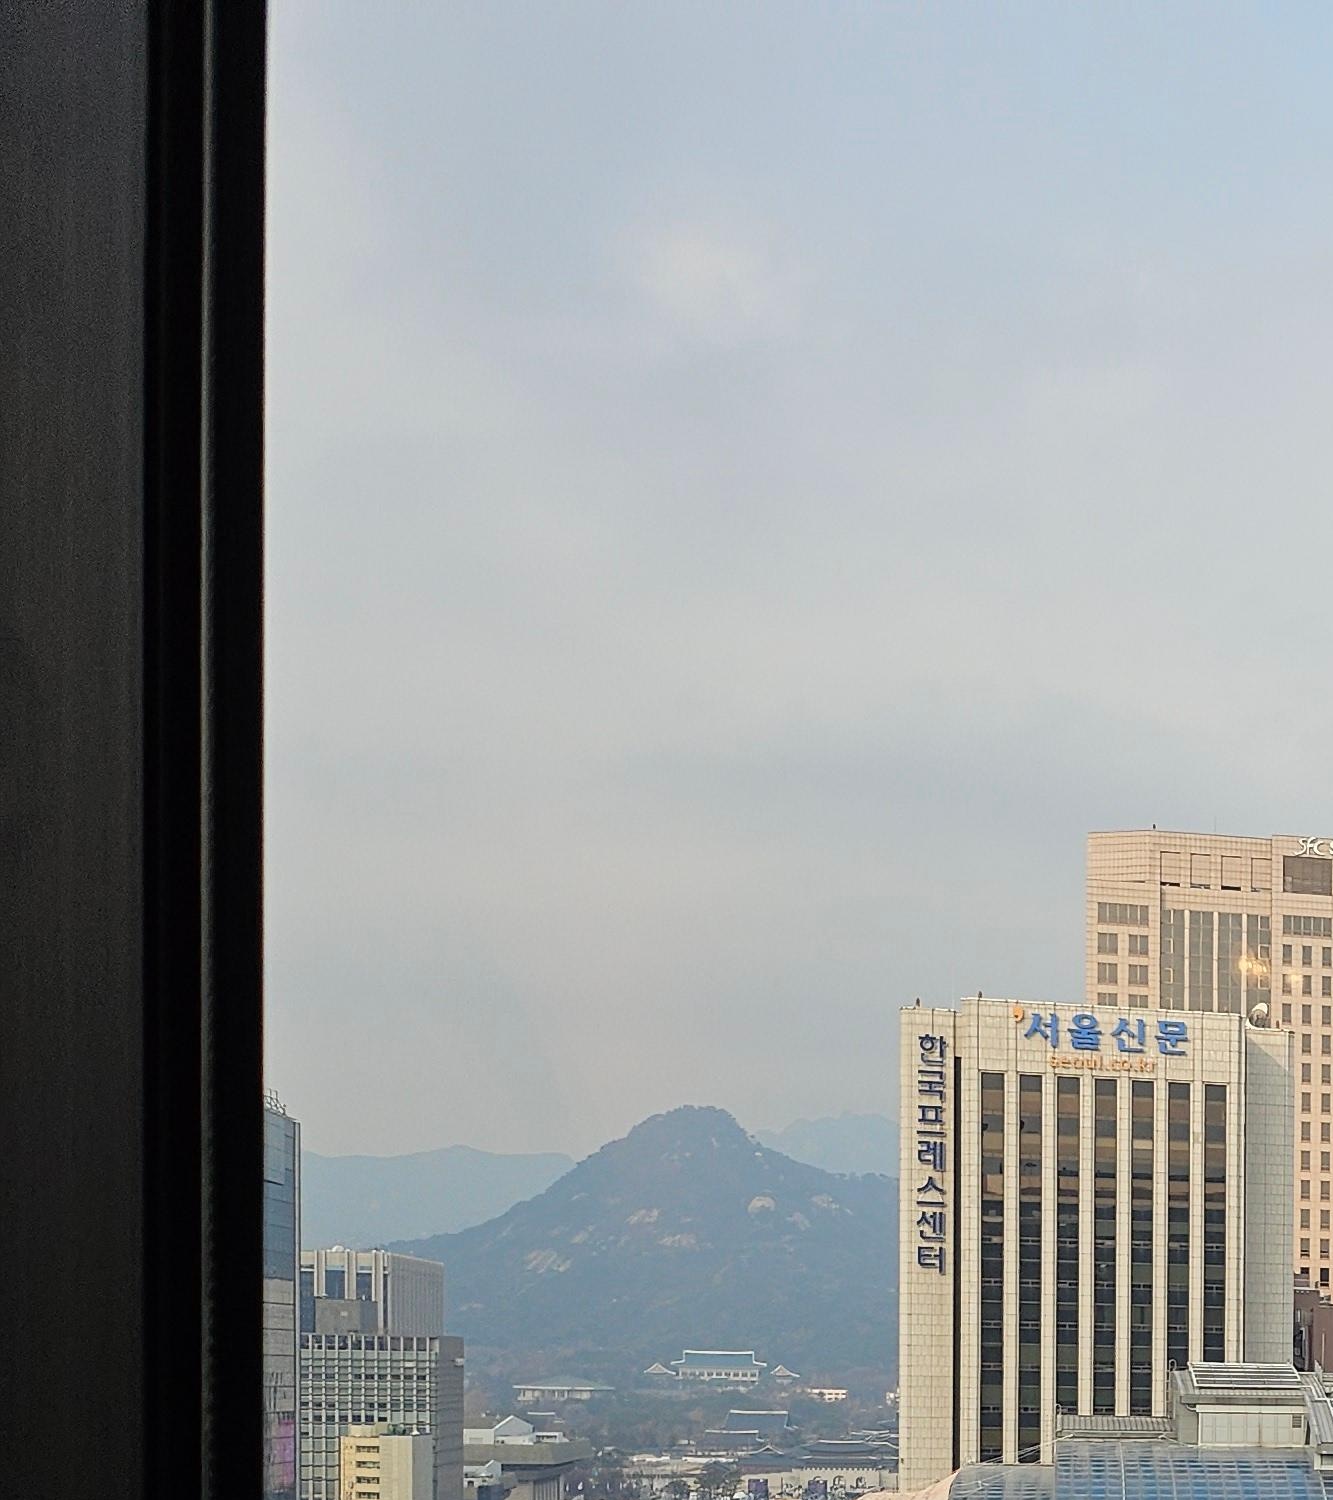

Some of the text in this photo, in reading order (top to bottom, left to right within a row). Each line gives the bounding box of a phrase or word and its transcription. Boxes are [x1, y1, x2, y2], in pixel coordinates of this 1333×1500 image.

[1024, 1012, 1190, 1056] 서울신문
[1049, 1055, 1157, 1073] seoul.co.kr
[916, 1033, 948, 1275] 한국프레스센터
